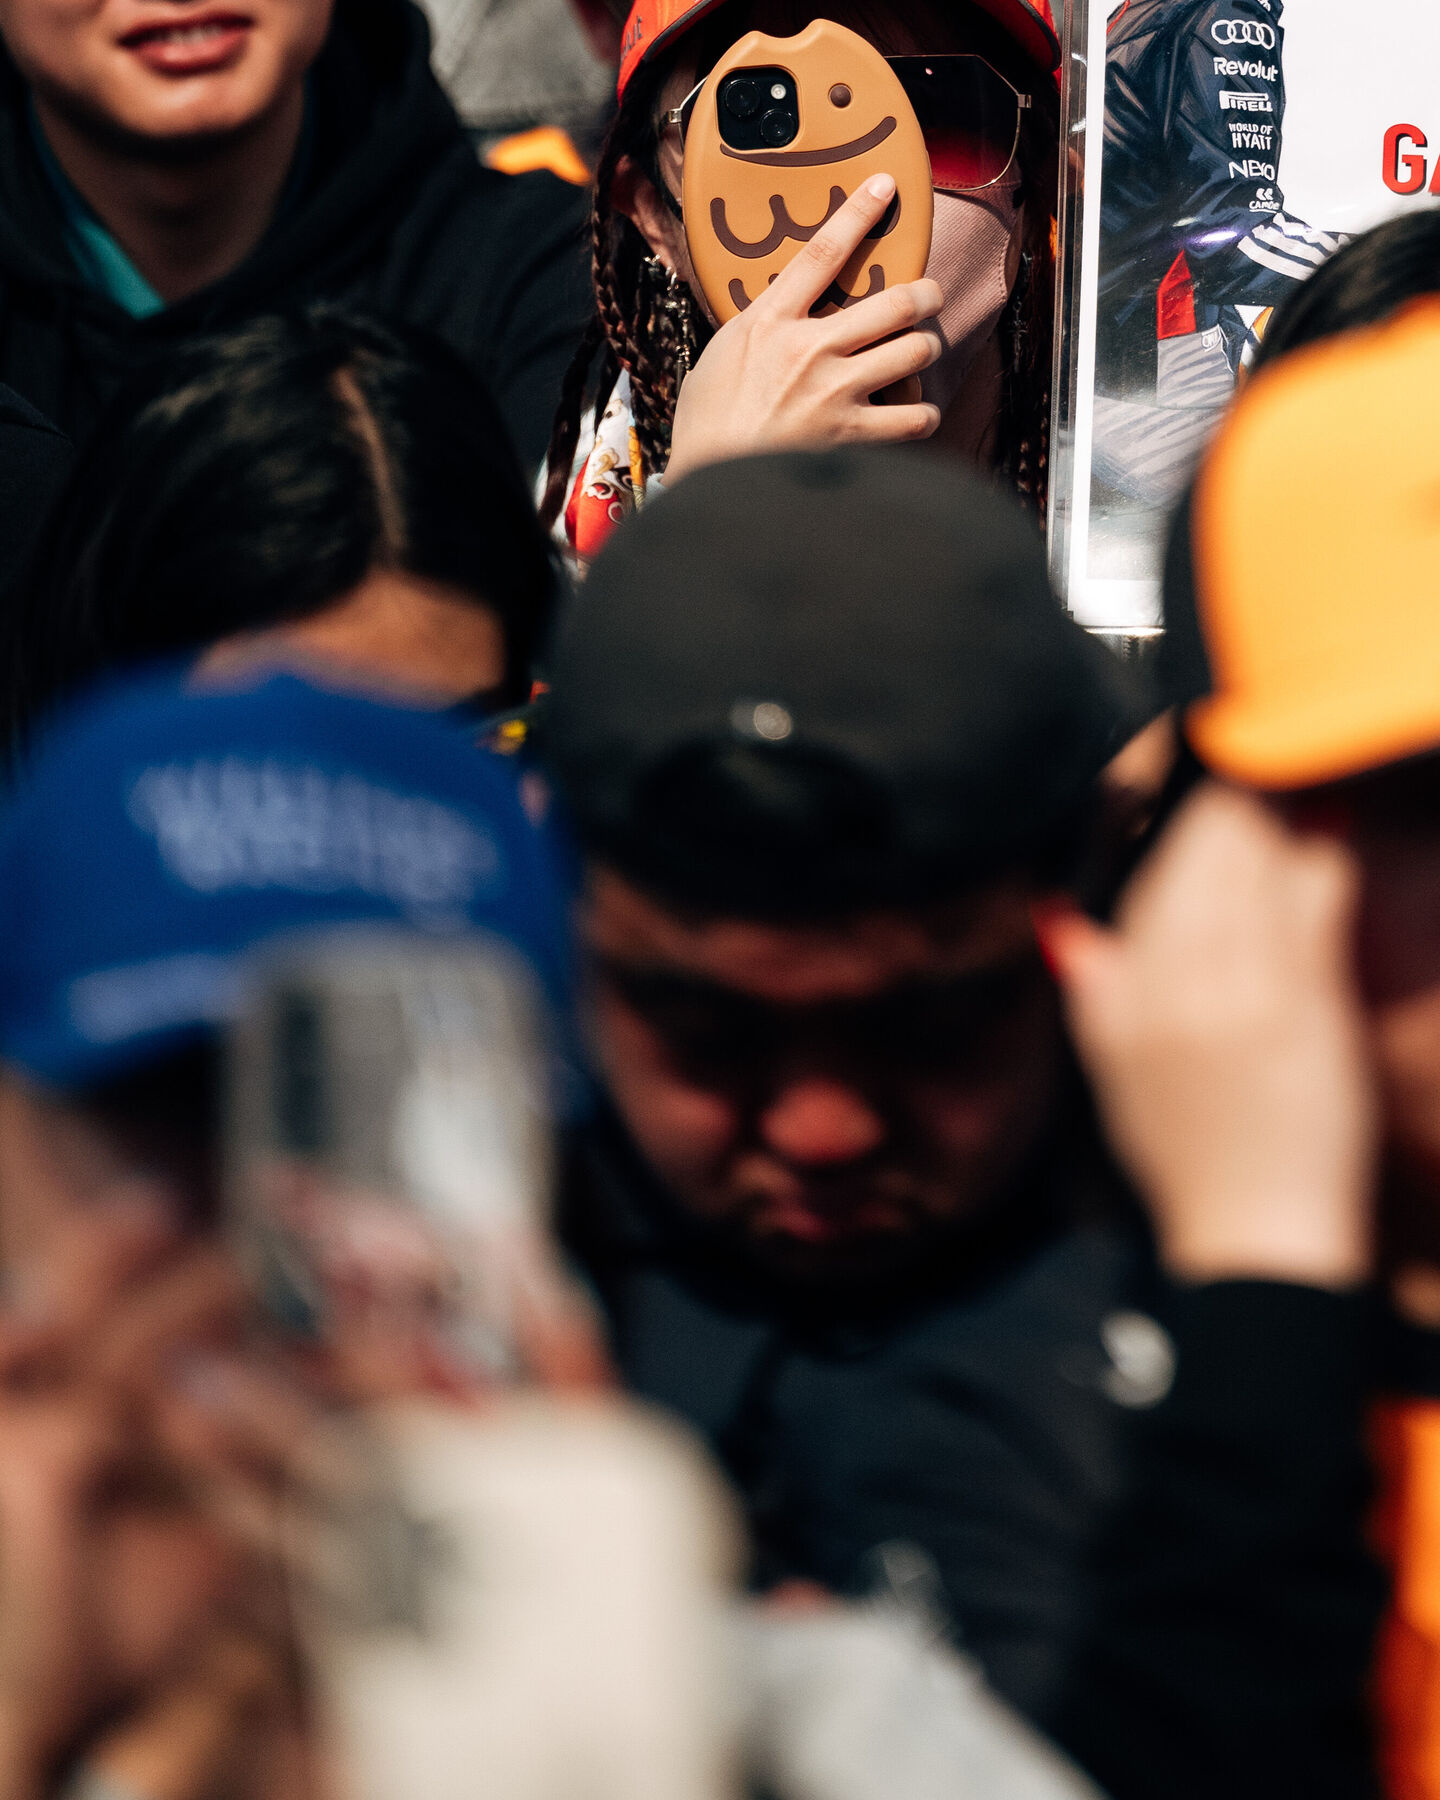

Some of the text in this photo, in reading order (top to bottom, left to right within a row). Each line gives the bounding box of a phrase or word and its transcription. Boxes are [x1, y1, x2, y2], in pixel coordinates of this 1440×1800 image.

[1213, 56, 1279, 82] Revolut
[1228, 122, 1273, 136] WORLD OF
[1231, 132, 1273, 151] HYATT
